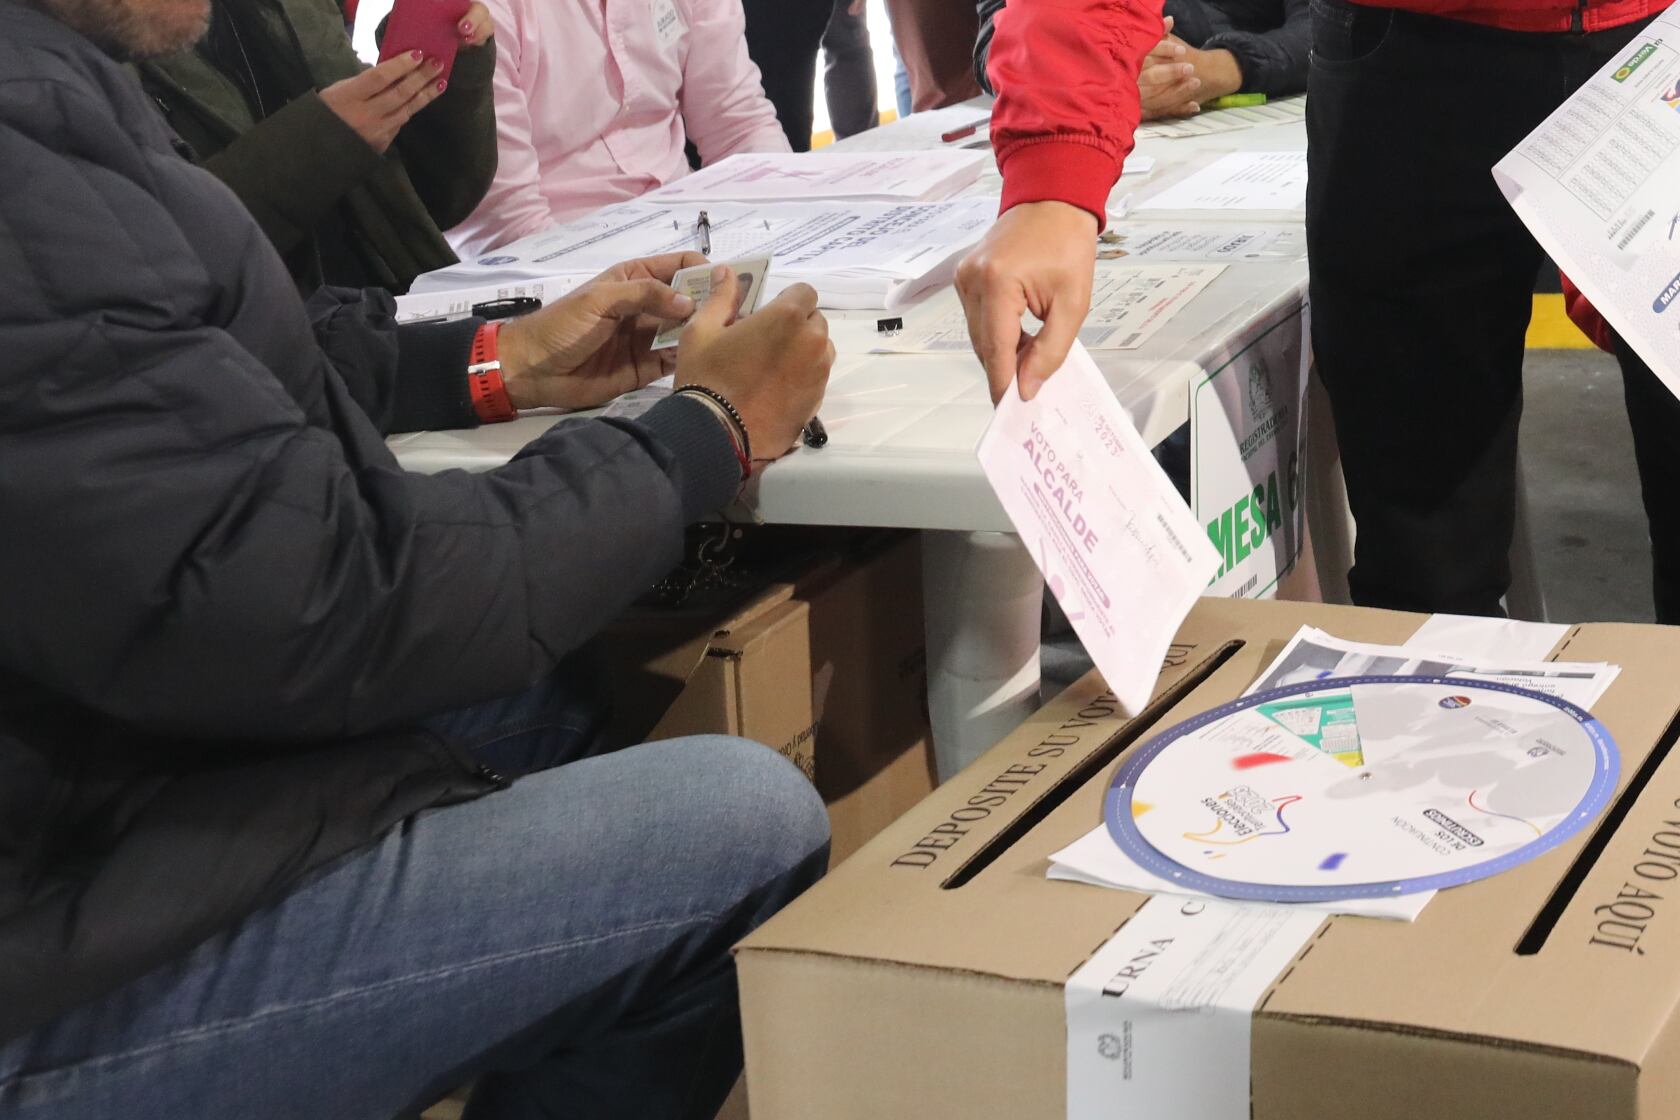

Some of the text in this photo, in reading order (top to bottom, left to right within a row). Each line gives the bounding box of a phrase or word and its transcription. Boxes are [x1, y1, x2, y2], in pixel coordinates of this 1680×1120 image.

[1626, 41, 1654, 71] Verde
[847, 206, 914, 236] DISTRITO
[870, 205, 937, 236] CONCEJO
[783, 237, 853, 266] CAPITAL
[1029, 420, 1085, 504] VOTO PARA
[1093, 423, 1118, 457] 2023
[1021, 438, 1099, 554] ALCALDE
[1206, 470, 1281, 576] MESA
[890, 762, 1048, 869] DEPOSITE
[1027, 733, 1081, 758] SU
[1059, 688, 1117, 730] VOT
[1200, 795, 1254, 837] Elecciones
[1589, 882, 1665, 956] AQUÍ
[1102, 936, 1175, 998] URNA
